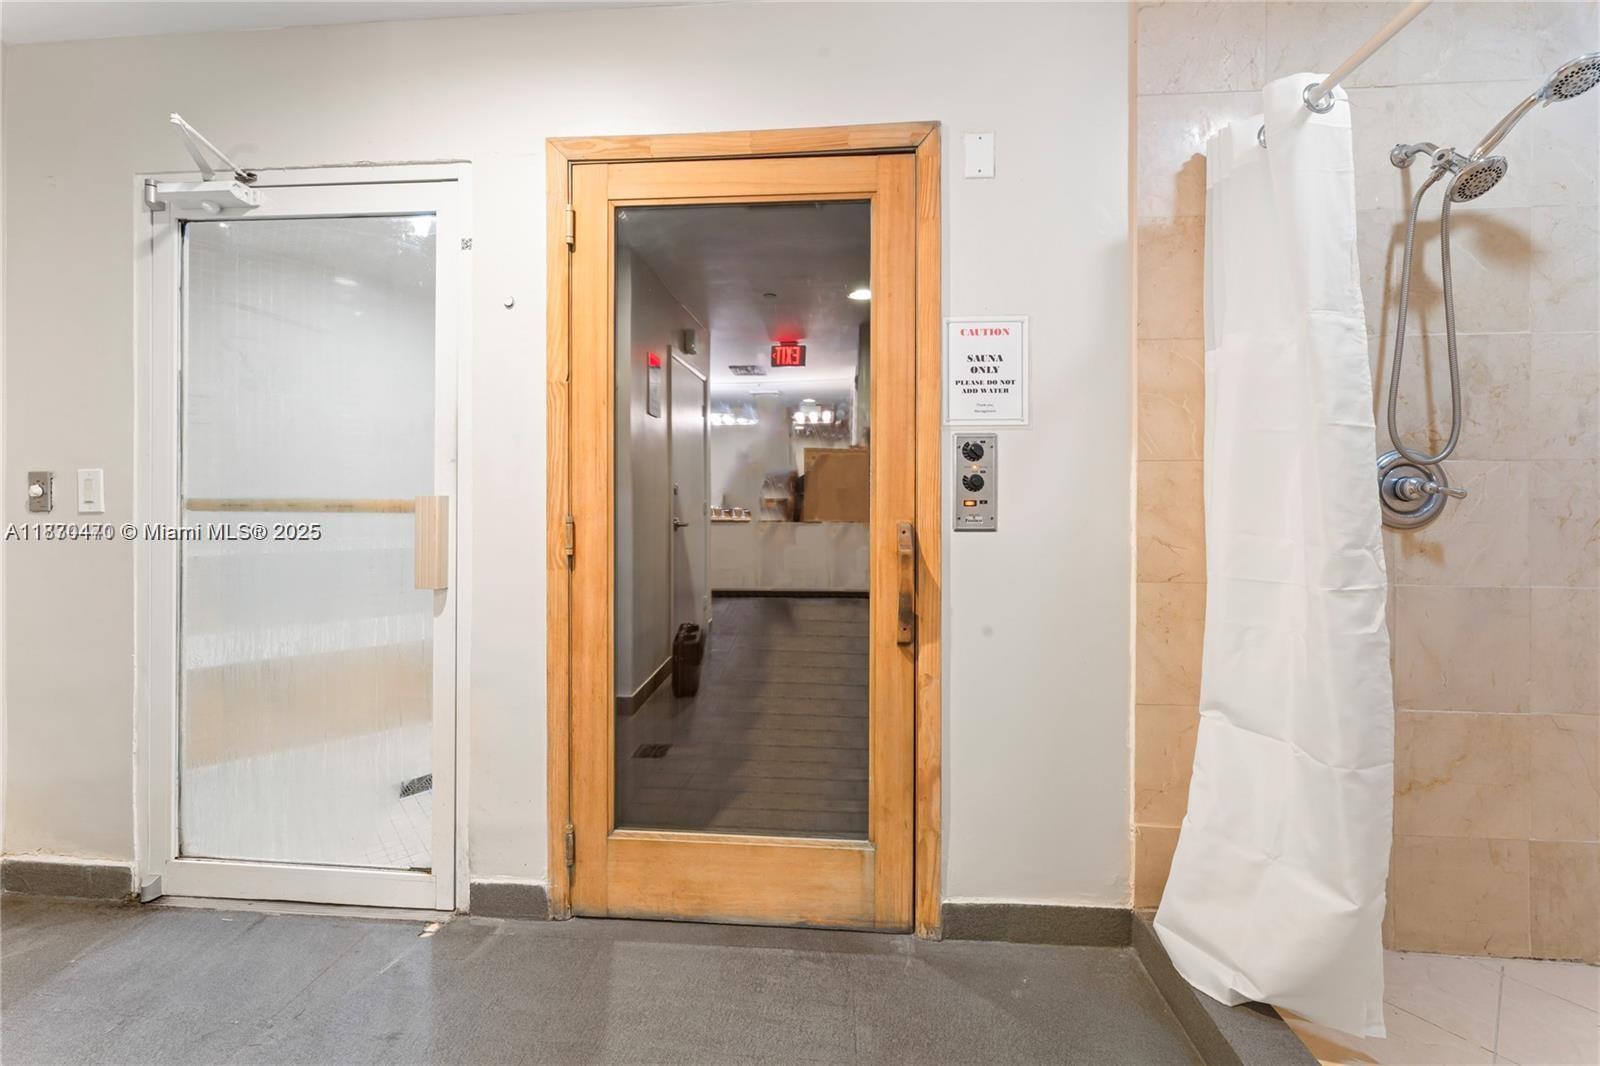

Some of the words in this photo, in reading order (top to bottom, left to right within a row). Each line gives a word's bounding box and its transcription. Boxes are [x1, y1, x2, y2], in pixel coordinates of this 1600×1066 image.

[960, 328, 1010, 336] CAUTION
[967, 354, 1003, 362] SAUNA
[970, 366, 1000, 374] ONLY
